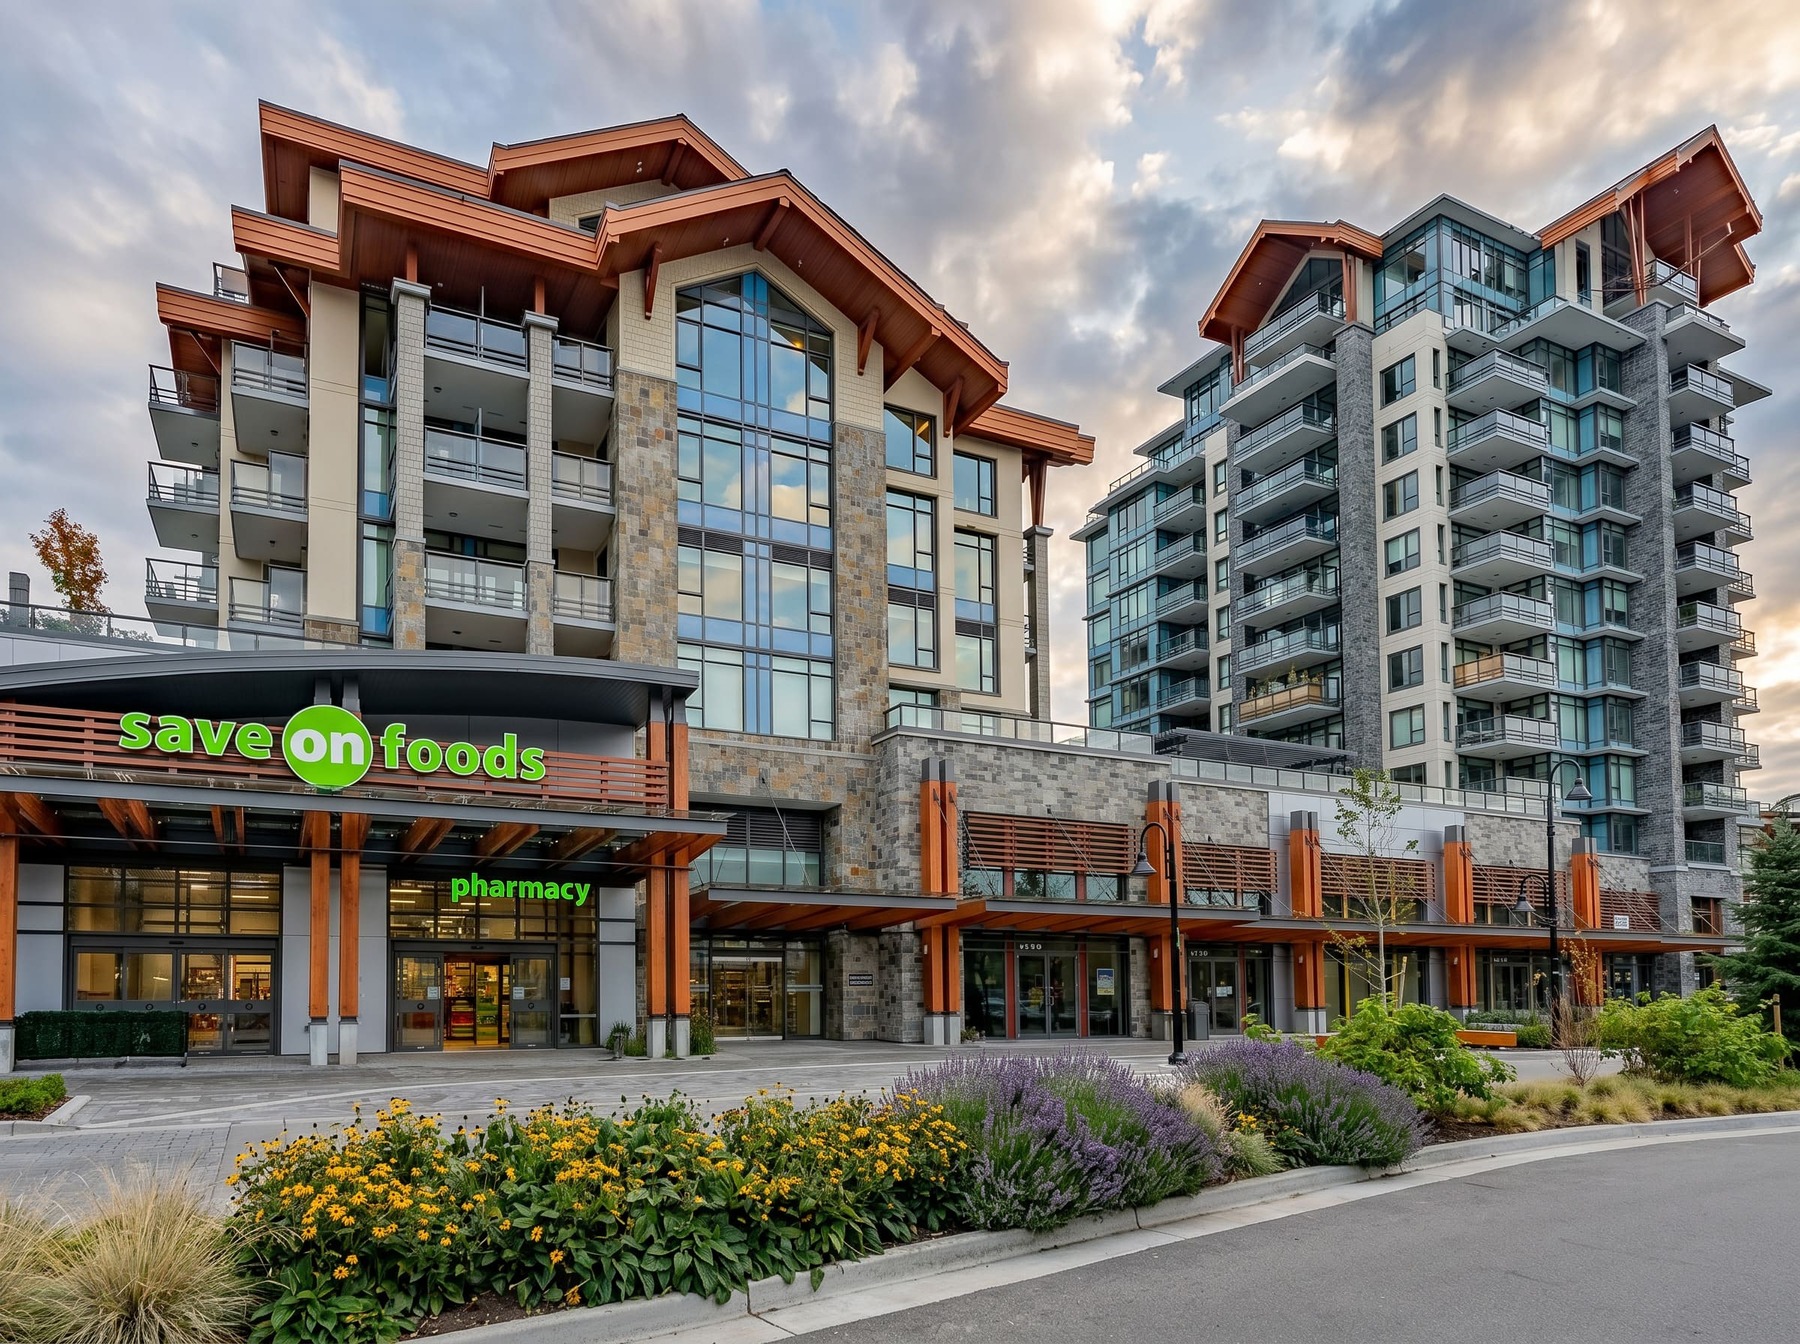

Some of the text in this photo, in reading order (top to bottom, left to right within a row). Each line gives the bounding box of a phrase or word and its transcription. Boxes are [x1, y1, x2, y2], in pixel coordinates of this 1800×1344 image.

[119, 711, 547, 781] save on foods
[451, 872, 591, 907] pharmacy
